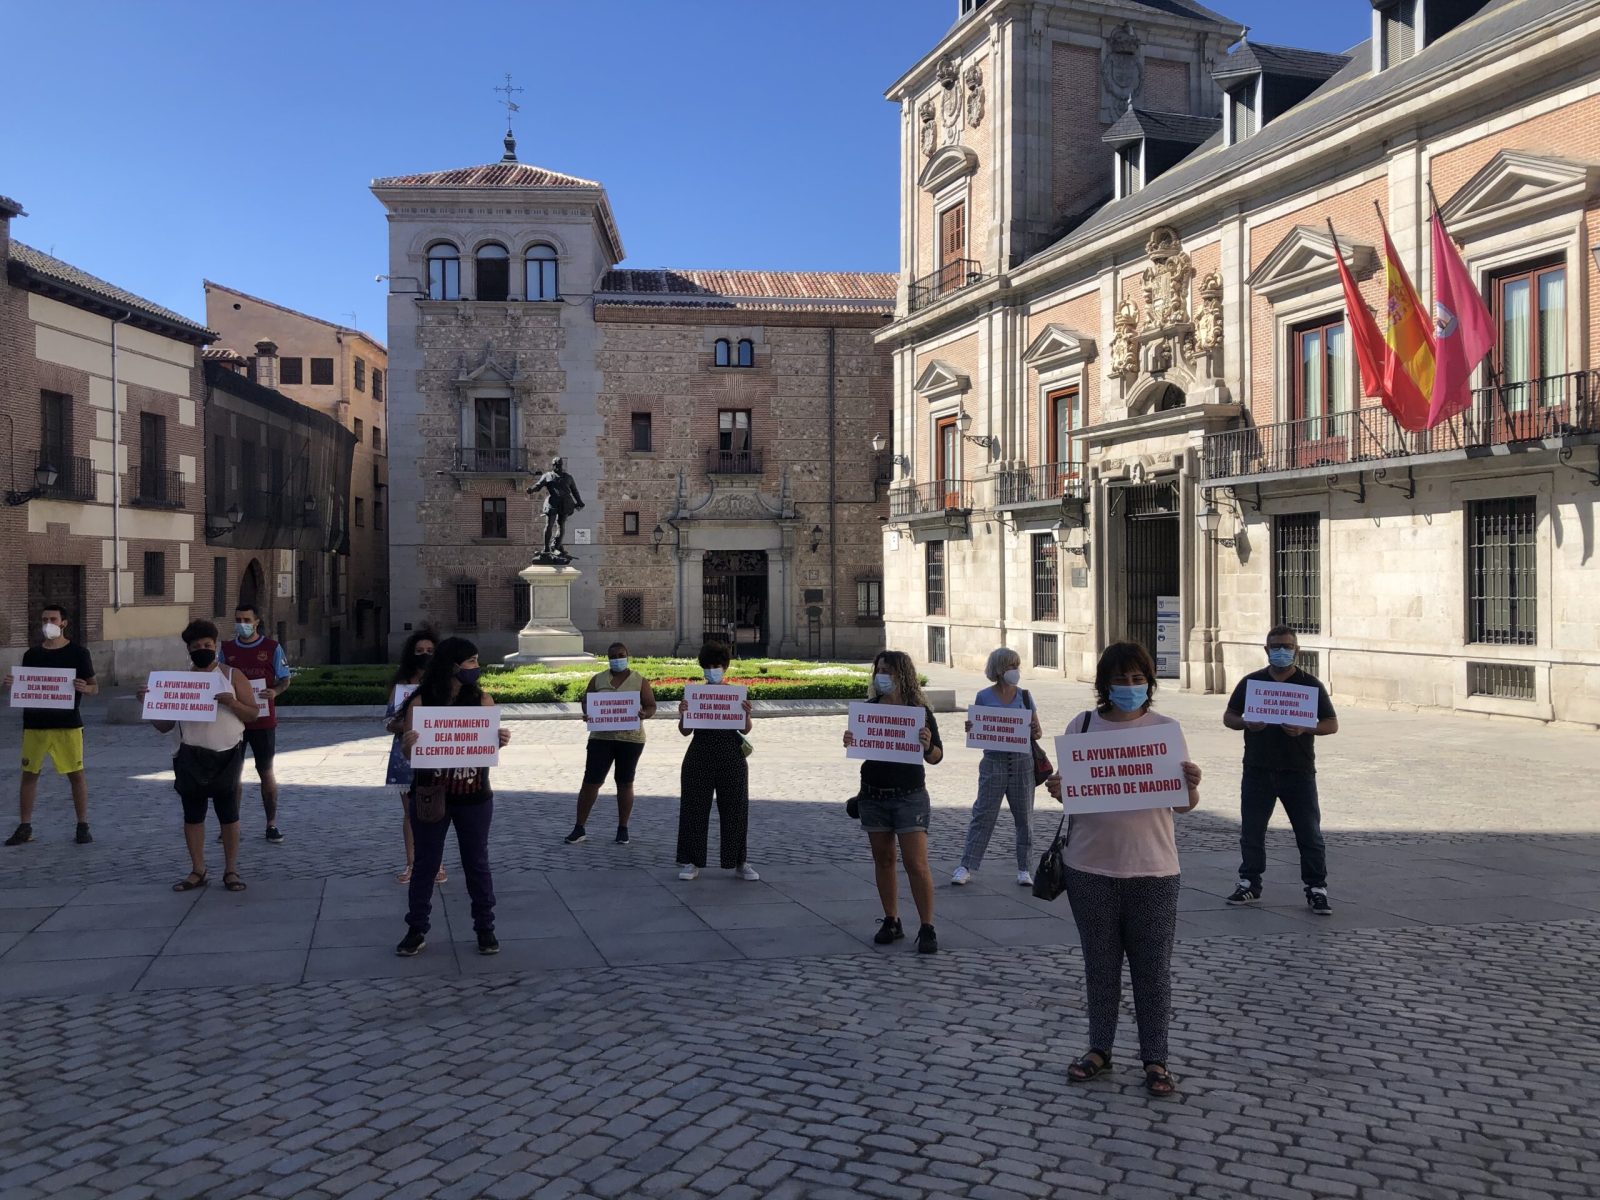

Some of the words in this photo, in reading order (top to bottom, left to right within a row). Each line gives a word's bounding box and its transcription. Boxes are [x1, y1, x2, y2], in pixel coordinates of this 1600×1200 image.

[164, 681, 210, 689] AYUNTAMIENTO
[1263, 690, 1309, 700] AYUNTAMIENTO
[156, 702, 179, 710] CENTRO
[1290, 710, 1313, 718] MADRID
[424, 720, 432, 728] EL
[434, 719, 490, 728] AYUNTAMIENTO
[858, 714, 865, 722] EL
[867, 715, 915, 726] AYUNTAMIENTO
[983, 715, 1023, 724] AYUNTAMIENTO
[435, 733, 452, 742] DEJA
[454, 733, 478, 742] MORIR
[868, 728, 883, 736] DEJA
[884, 729, 905, 738] MORIR
[1006, 736, 1027, 744] MADRID
[416, 747, 424, 755] EL
[426, 746, 454, 755] CENTRO
[456, 746, 464, 754] DE
[467, 746, 495, 754] MADRID
[860, 740, 884, 749] CENTRO
[886, 742, 893, 750] DE
[895, 742, 920, 752] MADRID
[1072, 750, 1084, 761] EL
[1087, 743, 1167, 760] AYUNTAMIENTO
[1091, 766, 1116, 778] DEJA
[1118, 763, 1153, 776] MORIR
[1067, 786, 1079, 797] EL
[1081, 783, 1121, 796] CENTRO
[1123, 782, 1137, 794] DE
[1139, 779, 1181, 792] MADRID
